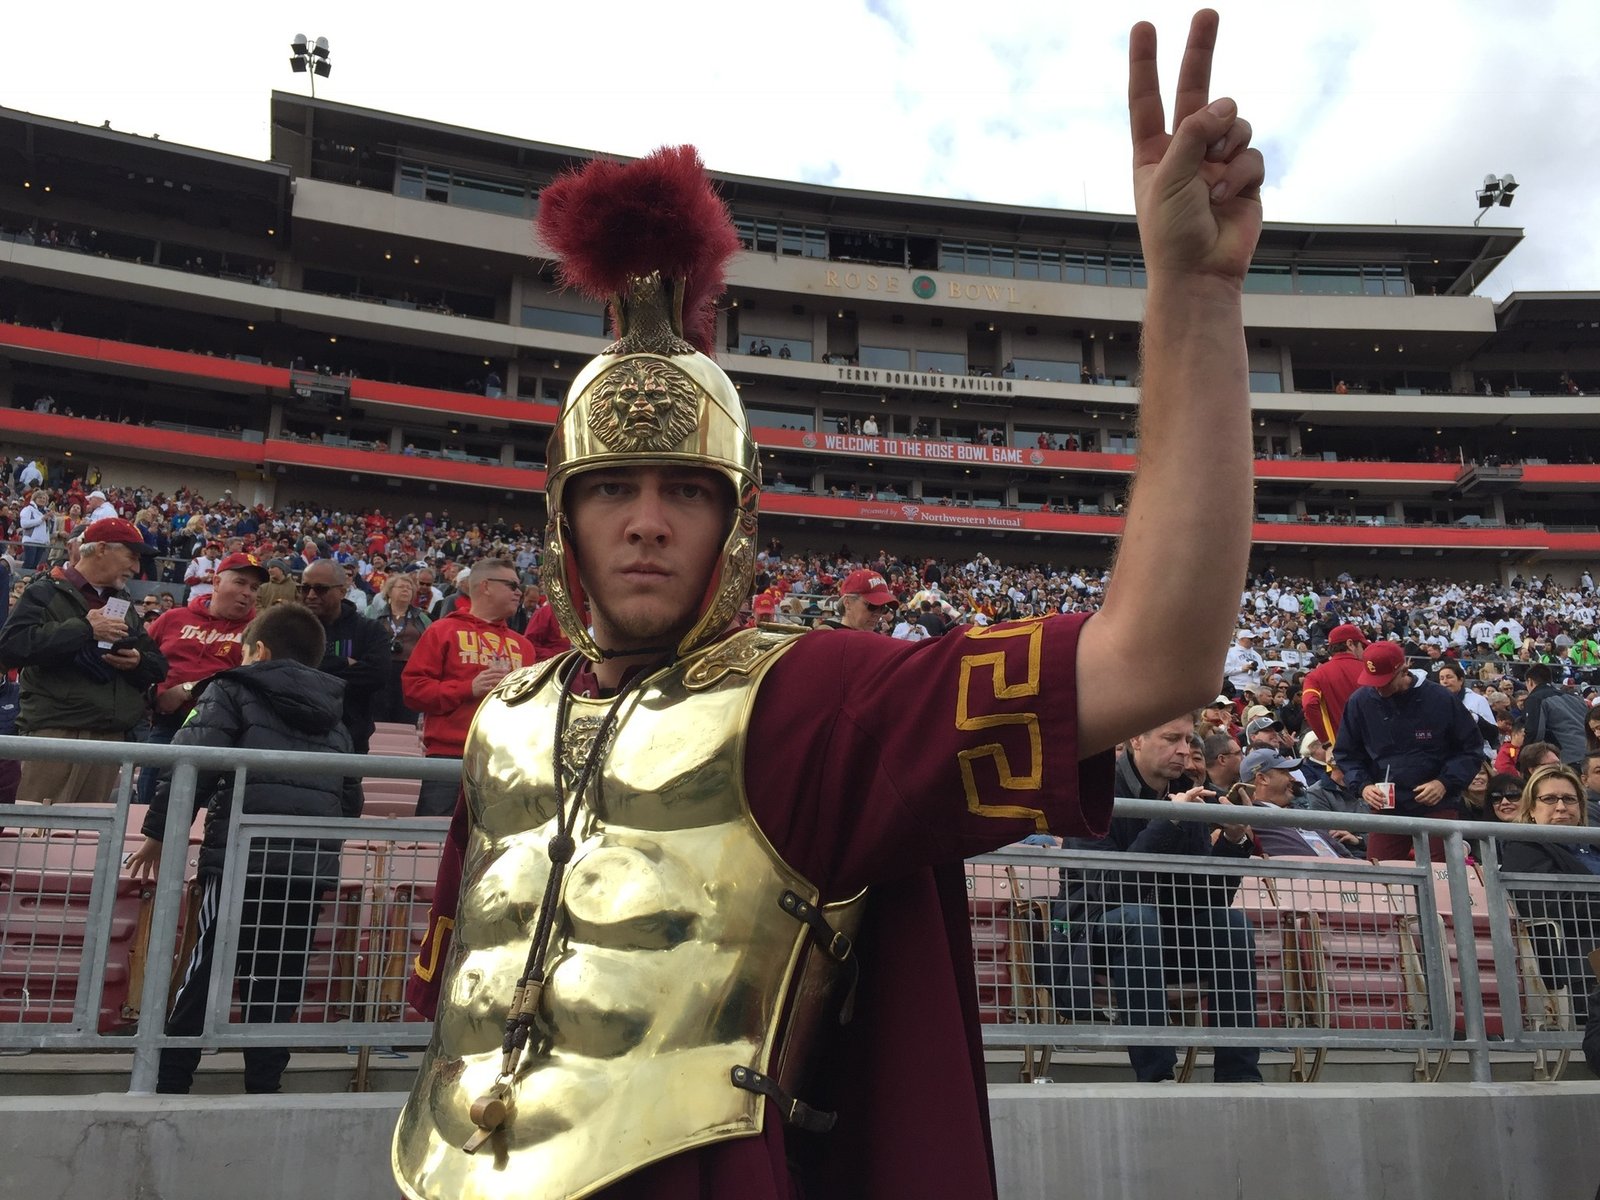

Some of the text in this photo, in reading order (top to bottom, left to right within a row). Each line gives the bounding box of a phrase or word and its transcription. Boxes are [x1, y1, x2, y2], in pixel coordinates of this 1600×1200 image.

[825, 270, 1020, 304] ROSE BOWL
[838, 368, 1013, 393] TERRY DONAHUE PAVILION
[824, 435, 1023, 464] WELCOME TO THE ROSE BOWL GAME
[921, 512, 1021, 527] Northwestern Mutual
[457, 630, 522, 661] USC
[1480, 627, 1490, 638] 17
